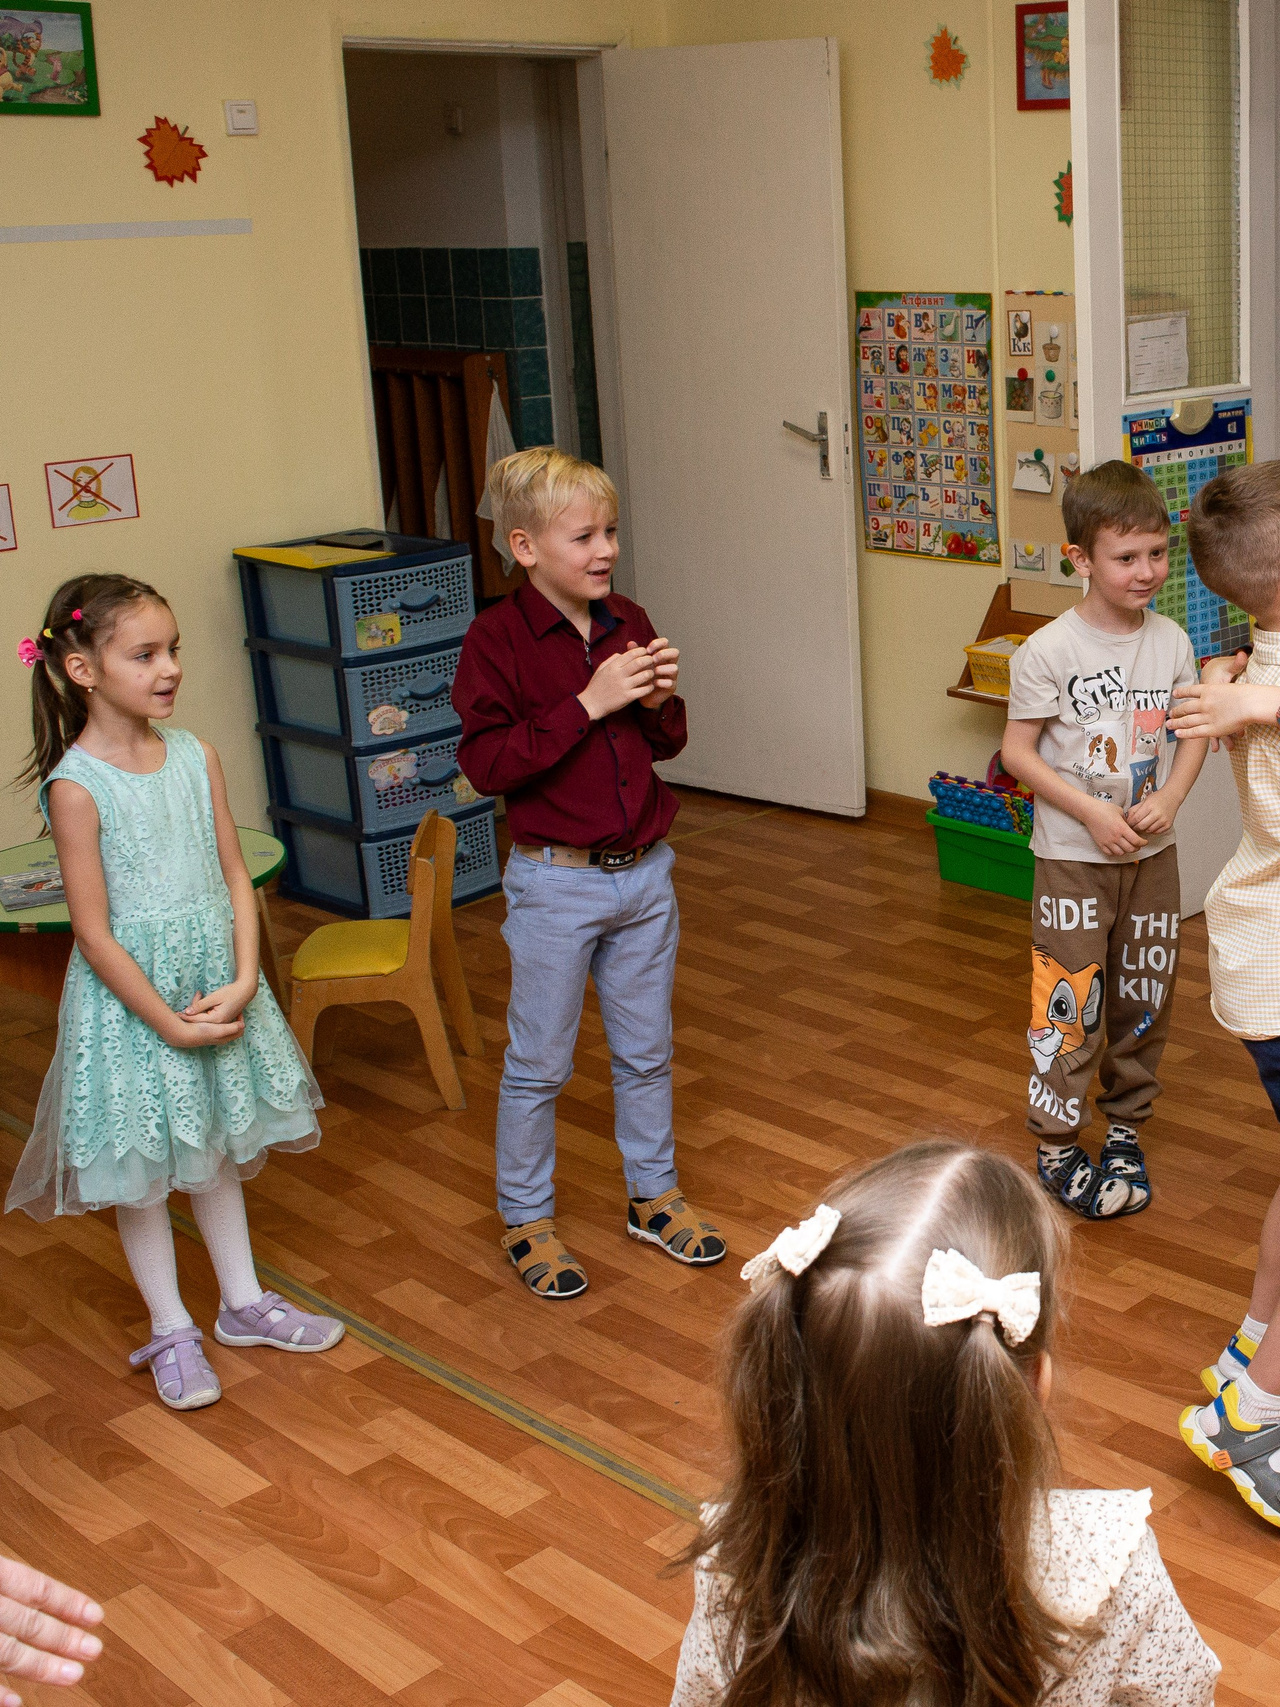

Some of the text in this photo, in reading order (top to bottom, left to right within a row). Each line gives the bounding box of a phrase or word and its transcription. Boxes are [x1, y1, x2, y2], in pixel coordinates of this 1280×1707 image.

[902, 294, 944, 307] Алфавит
[863, 313, 974, 330] А Б В Г Д
[862, 343, 975, 363] Е Ё Ж З И
[1012, 338, 1031, 353] Кк
[864, 377, 976, 399] Й К Л М Н
[865, 416, 976, 435] О П Р С Т
[1132, 418, 1166, 432] УЧИМСЯ
[1133, 433, 1167, 446] ЧИТАТЬ
[867, 450, 977, 471] У Ф Х Ц Ч
[1167, 453, 1171, 461] Ё
[894, 485, 906, 500] Щ
[920, 488, 929, 501] Ъ
[944, 490, 956, 504] Ы
[972, 492, 979, 506] Ь
[871, 518, 931, 536] Э Ю Я
[1189, 603, 1196, 611] СО
[1068, 666, 1128, 717] STAY
[1040, 895, 1099, 931] SIDE
[1131, 913, 1179, 939] THE
[1119, 975, 1168, 1010] KIN
